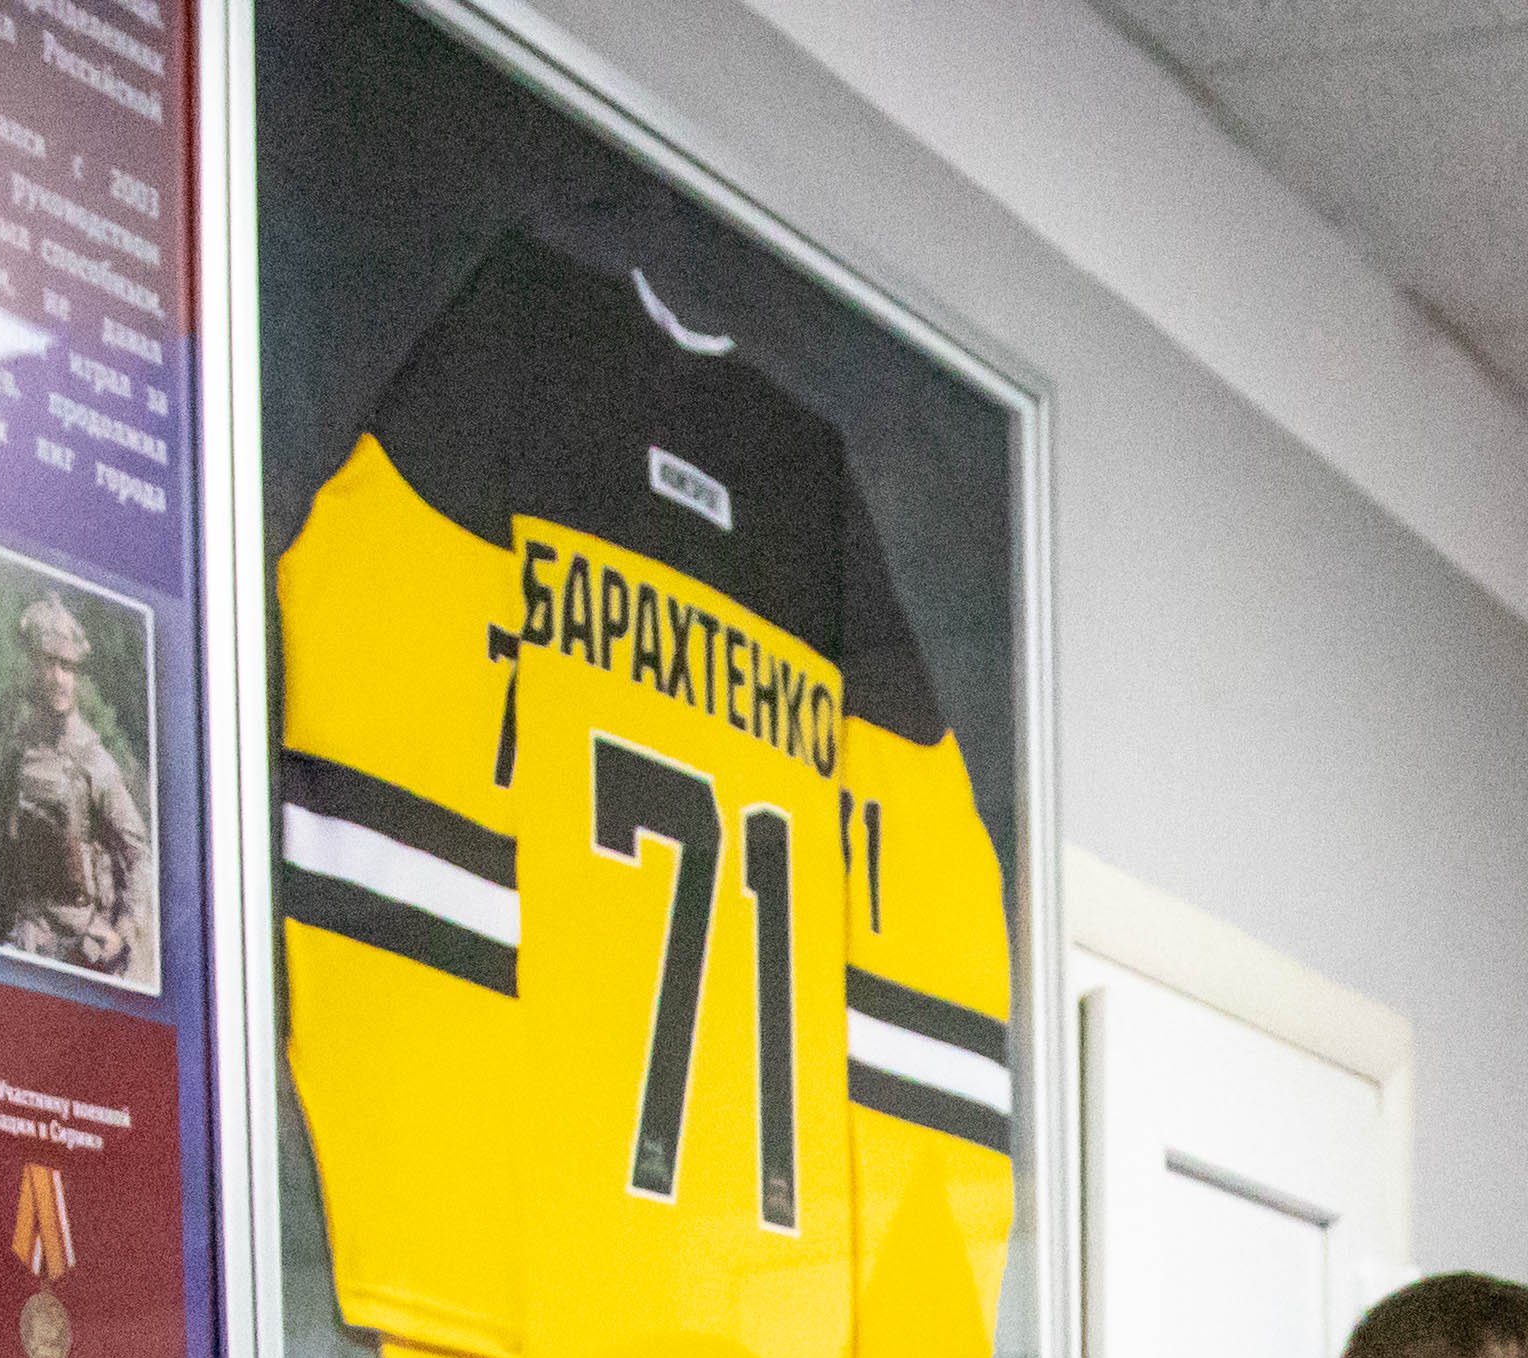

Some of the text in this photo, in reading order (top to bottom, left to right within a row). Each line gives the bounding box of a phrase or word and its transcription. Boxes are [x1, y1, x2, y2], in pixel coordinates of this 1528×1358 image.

[12, 171, 162, 268] руководством
[520, 539, 839, 779] БАРАХТЕНКО
[590, 727, 801, 1236] 71
